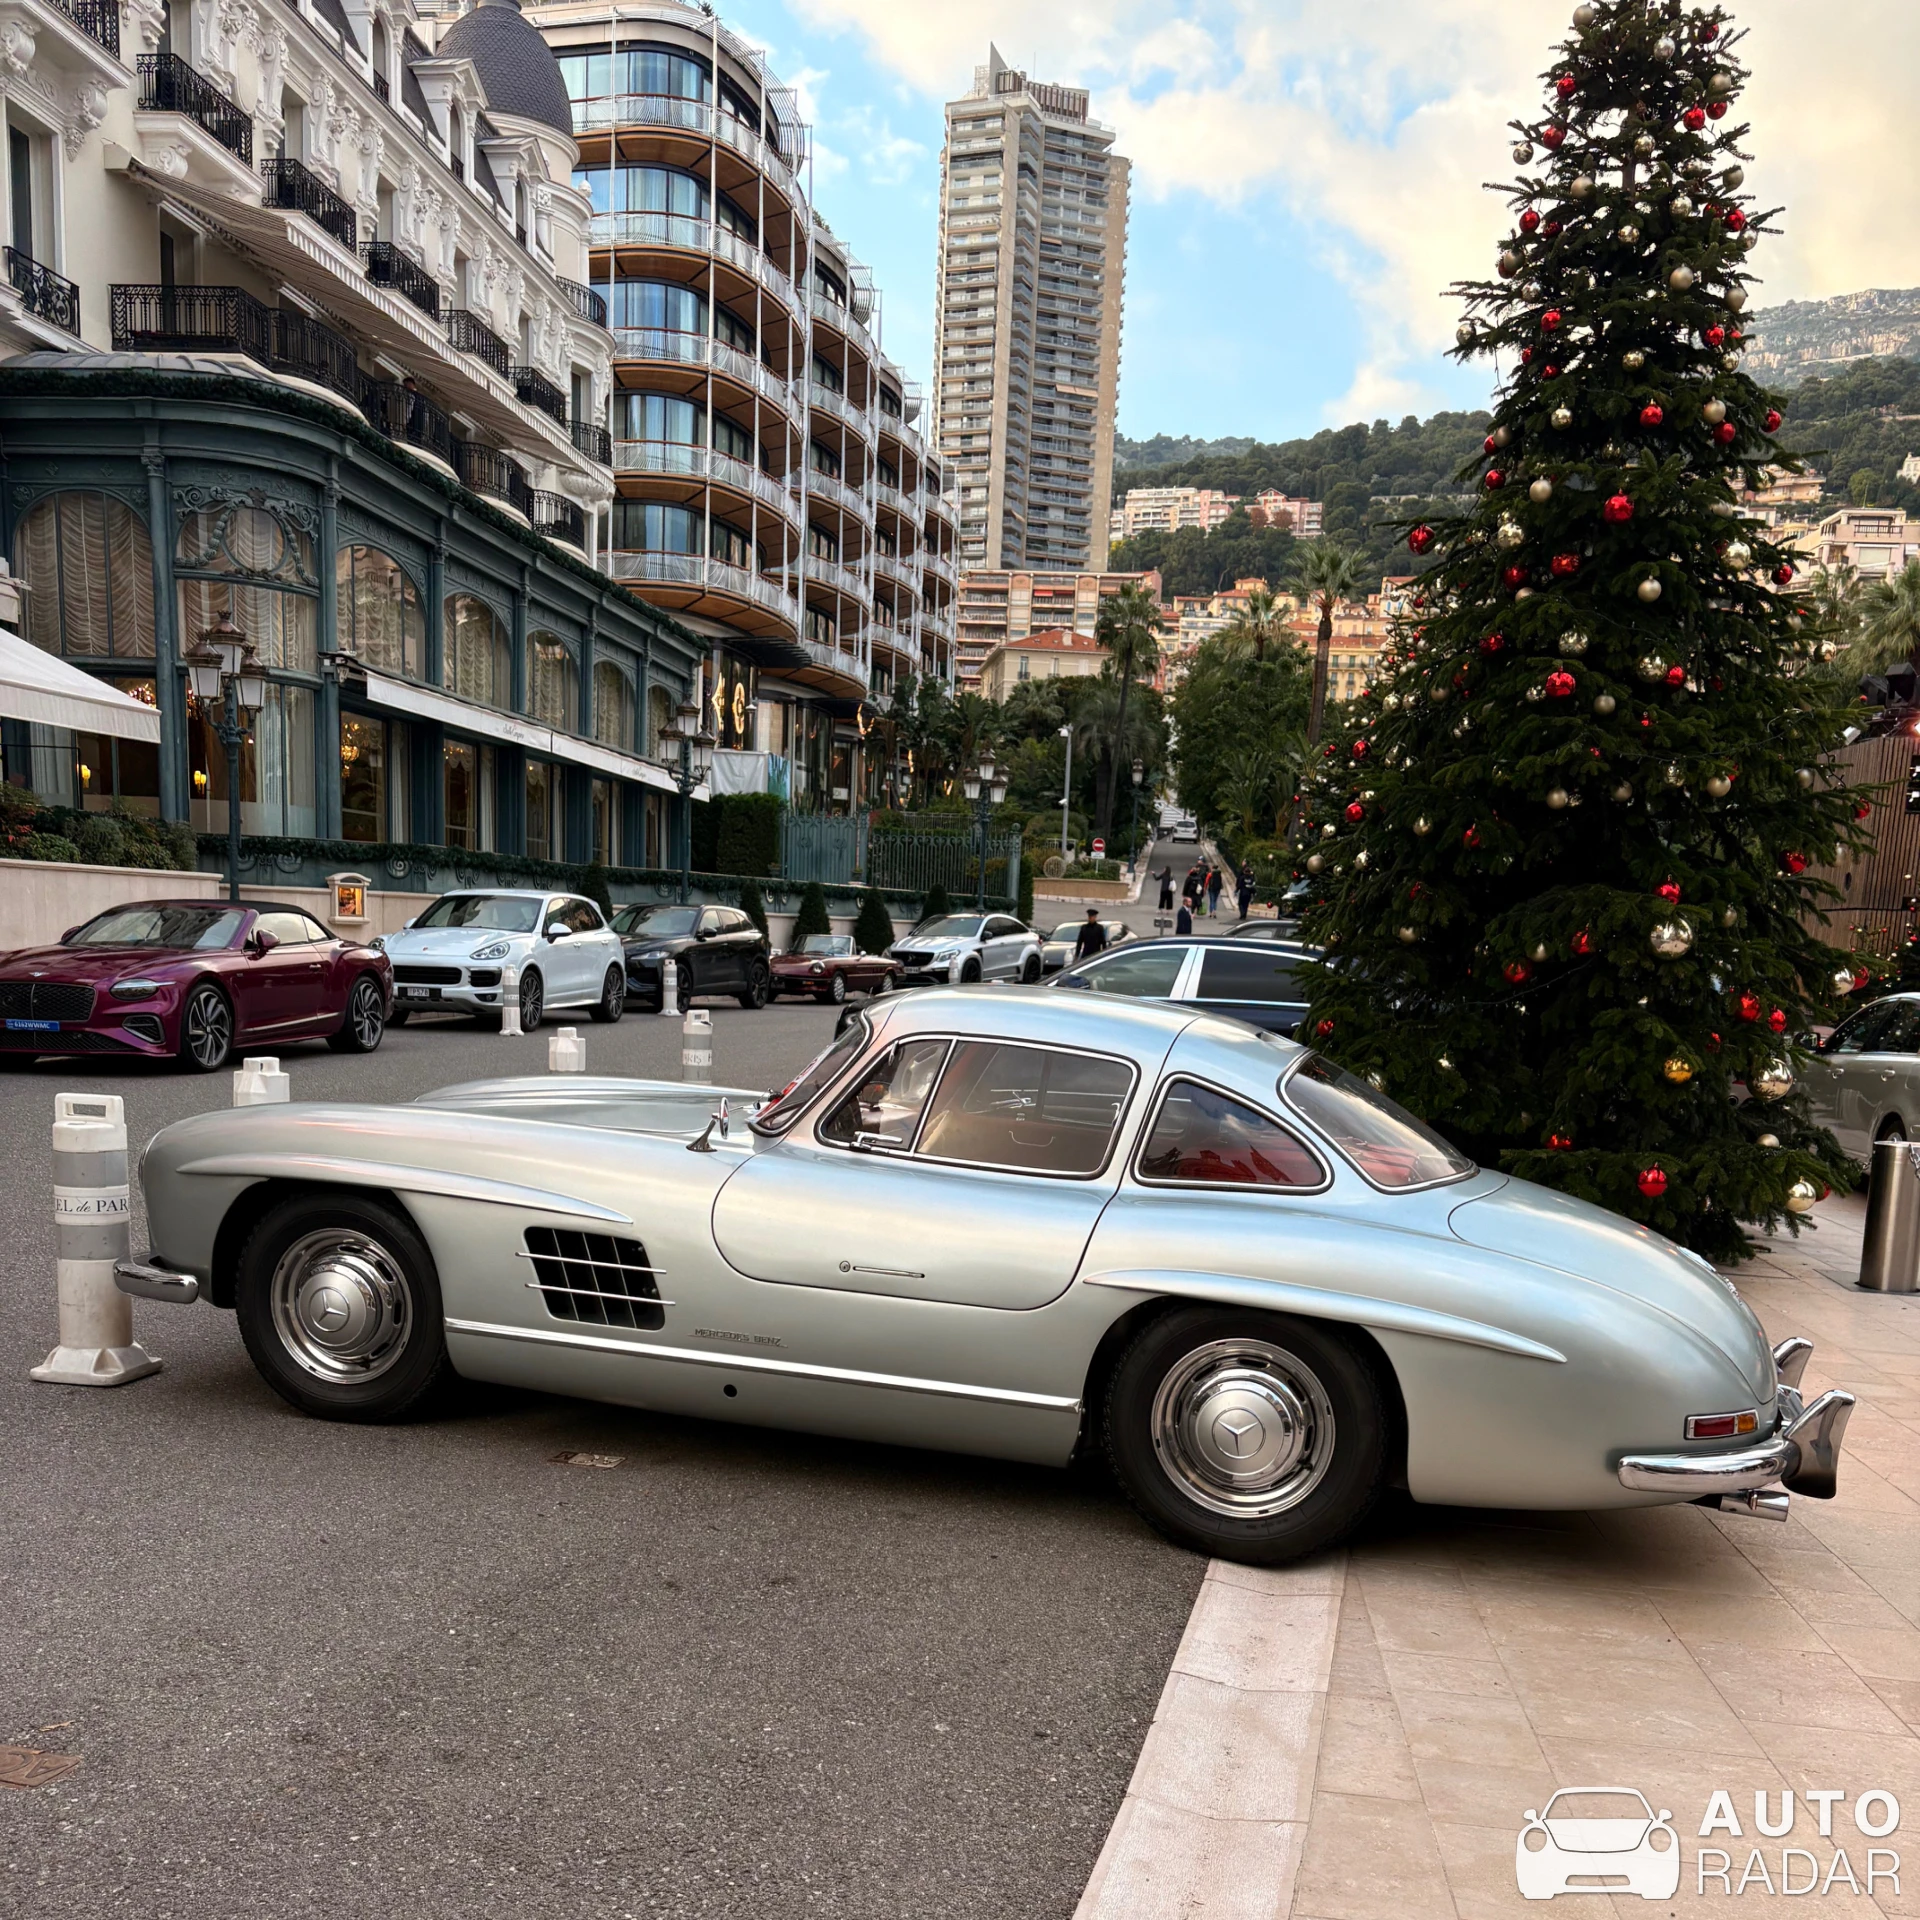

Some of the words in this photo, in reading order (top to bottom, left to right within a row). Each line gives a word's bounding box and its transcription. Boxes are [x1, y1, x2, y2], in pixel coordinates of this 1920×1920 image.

[76, 1200, 91, 1213] de
[96, 1198, 129, 1213] PAR
[694, 1328, 750, 1342] MERCEDES
[753, 1335, 781, 1347] BENZ
